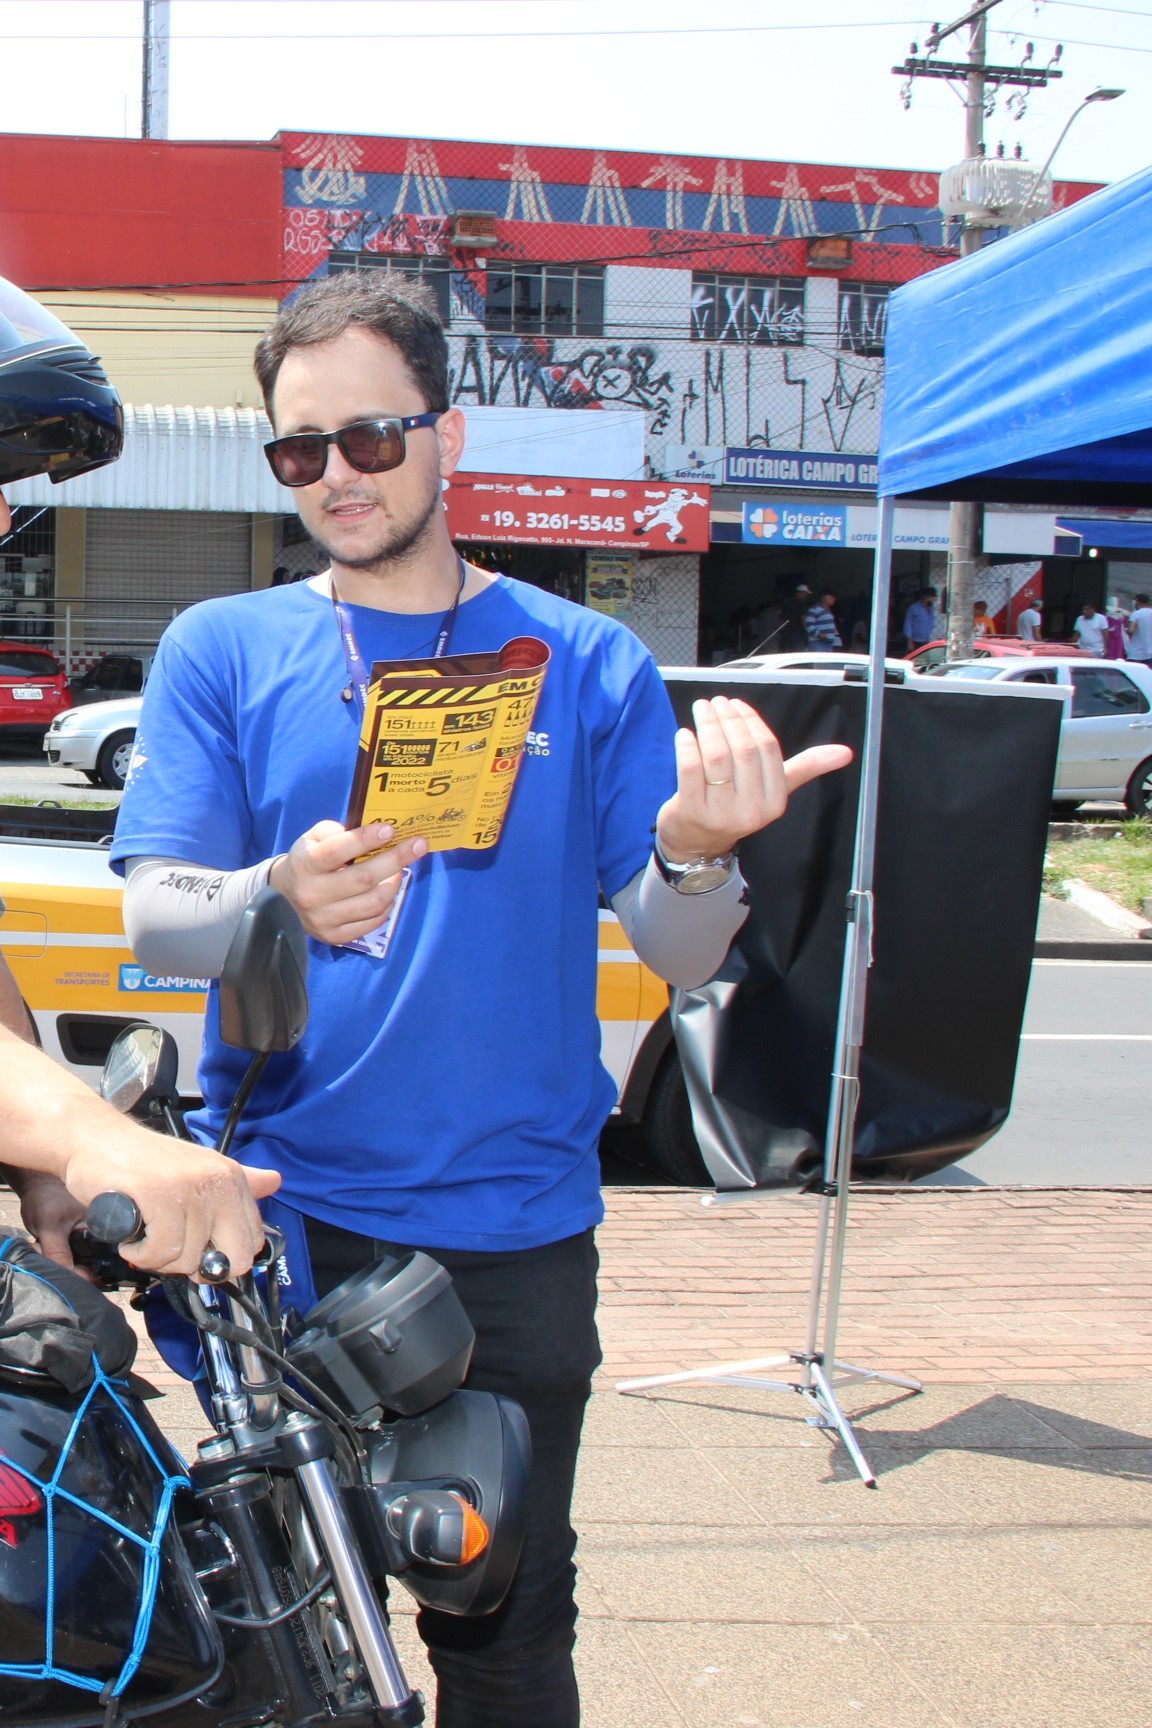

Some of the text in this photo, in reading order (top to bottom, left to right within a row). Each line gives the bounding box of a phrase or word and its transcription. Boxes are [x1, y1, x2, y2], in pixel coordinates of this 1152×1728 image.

[675, 469, 716, 480] Loterias
[729, 455, 878, 484] LOTÉRICA CAMPO GR
[493, 511, 625, 532] 19. 3261-5545
[782, 510, 842, 526] loterias
[782, 525, 842, 541] CAIXA
[894, 535, 925, 544] CAMPO
[498, 681, 528, 693] EM
[385, 720, 411, 729] 151
[455, 711, 494, 727] 143
[382, 745, 407, 754] 151
[439, 741, 459, 753] 71
[391, 757, 426, 765] 2022
[374, 770, 453, 792] 1 motociclista
[425, 775, 452, 796] 5
[451, 773, 477, 783] dias
